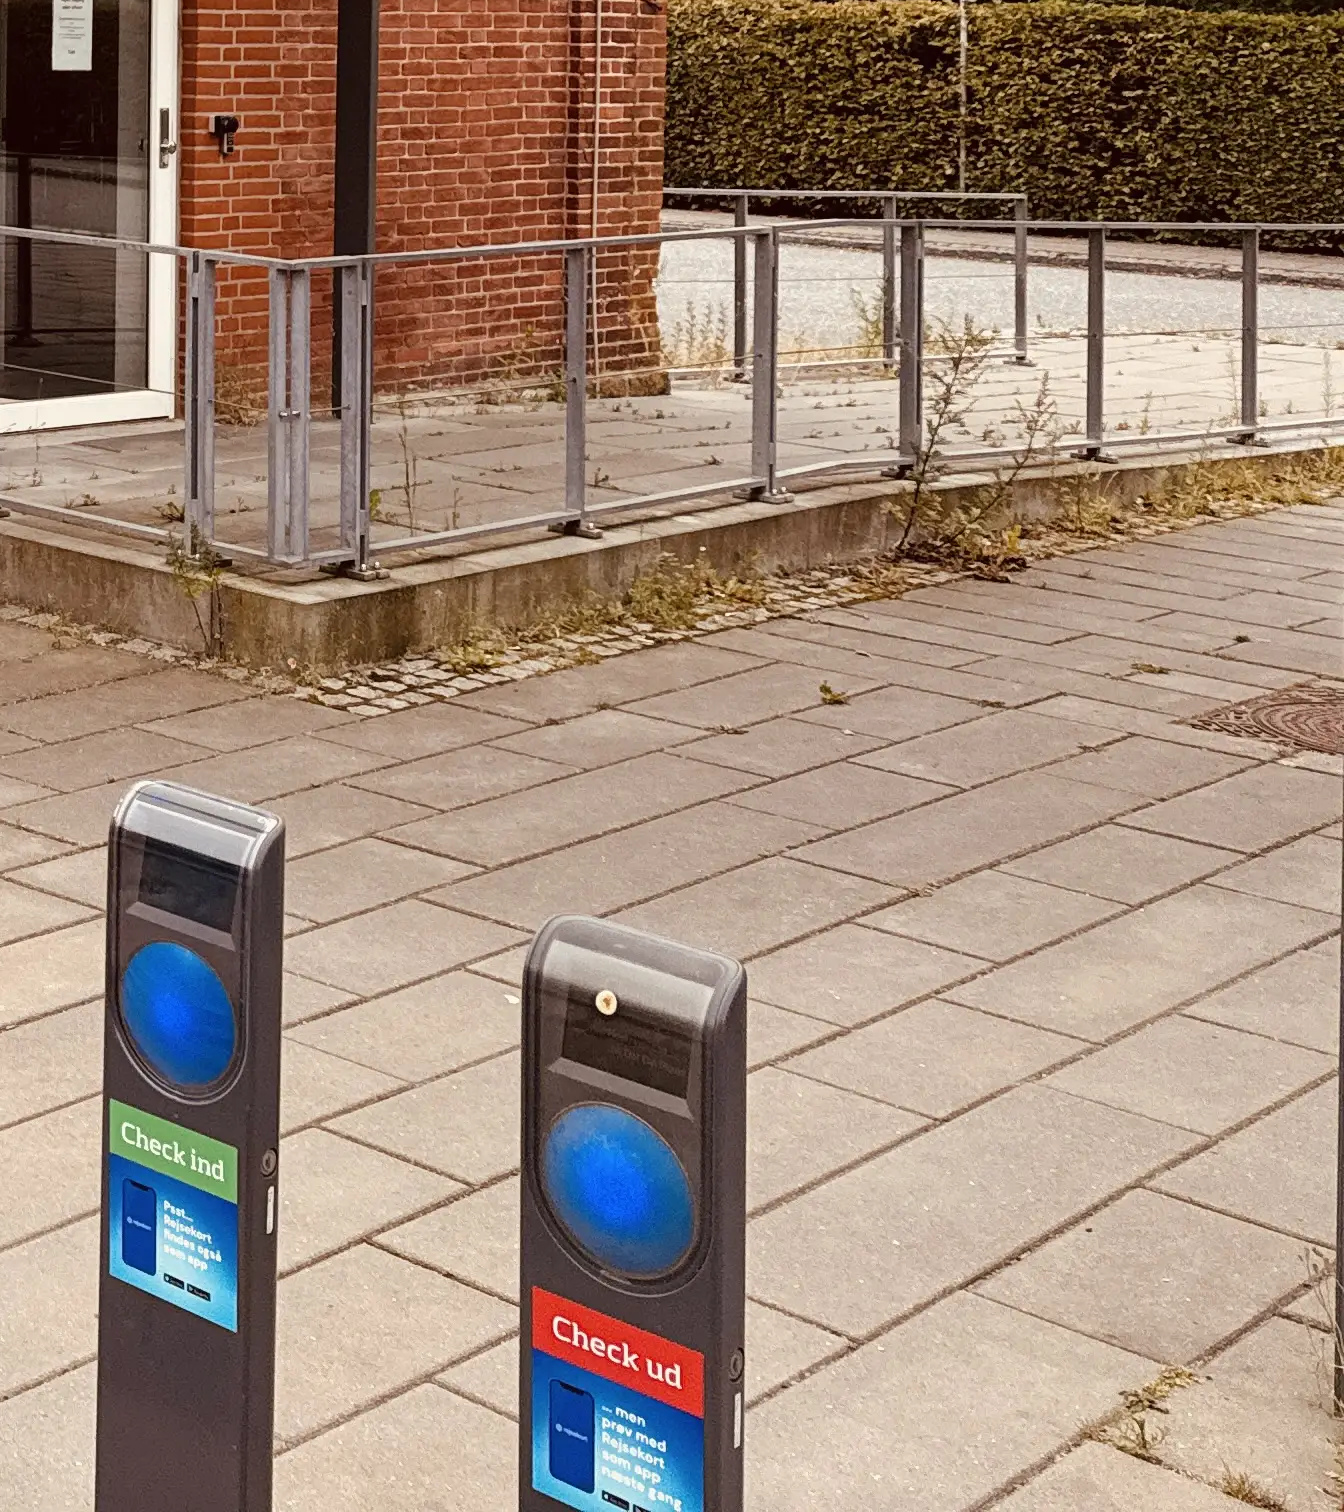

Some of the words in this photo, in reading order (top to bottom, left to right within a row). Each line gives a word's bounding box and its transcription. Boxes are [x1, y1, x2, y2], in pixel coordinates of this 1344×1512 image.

[121, 1121, 187, 1167] Check
[190, 1148, 225, 1182] ind
[163, 1213, 213, 1245] Rejsekort
[187, 1255, 208, 1271] app
[552, 1315, 640, 1372] Check
[645, 1357, 683, 1390] ud
[601, 1416, 633, 1438] prøv
[635, 1431, 667, 1453] med
[615, 1406, 646, 1428] men
[601, 1432, 666, 1469] Rejsekort
[601, 1449, 632, 1470] som
[634, 1464, 662, 1485] app
[601, 1465, 646, 1493] næste
[647, 1486, 683, 1512] gang
